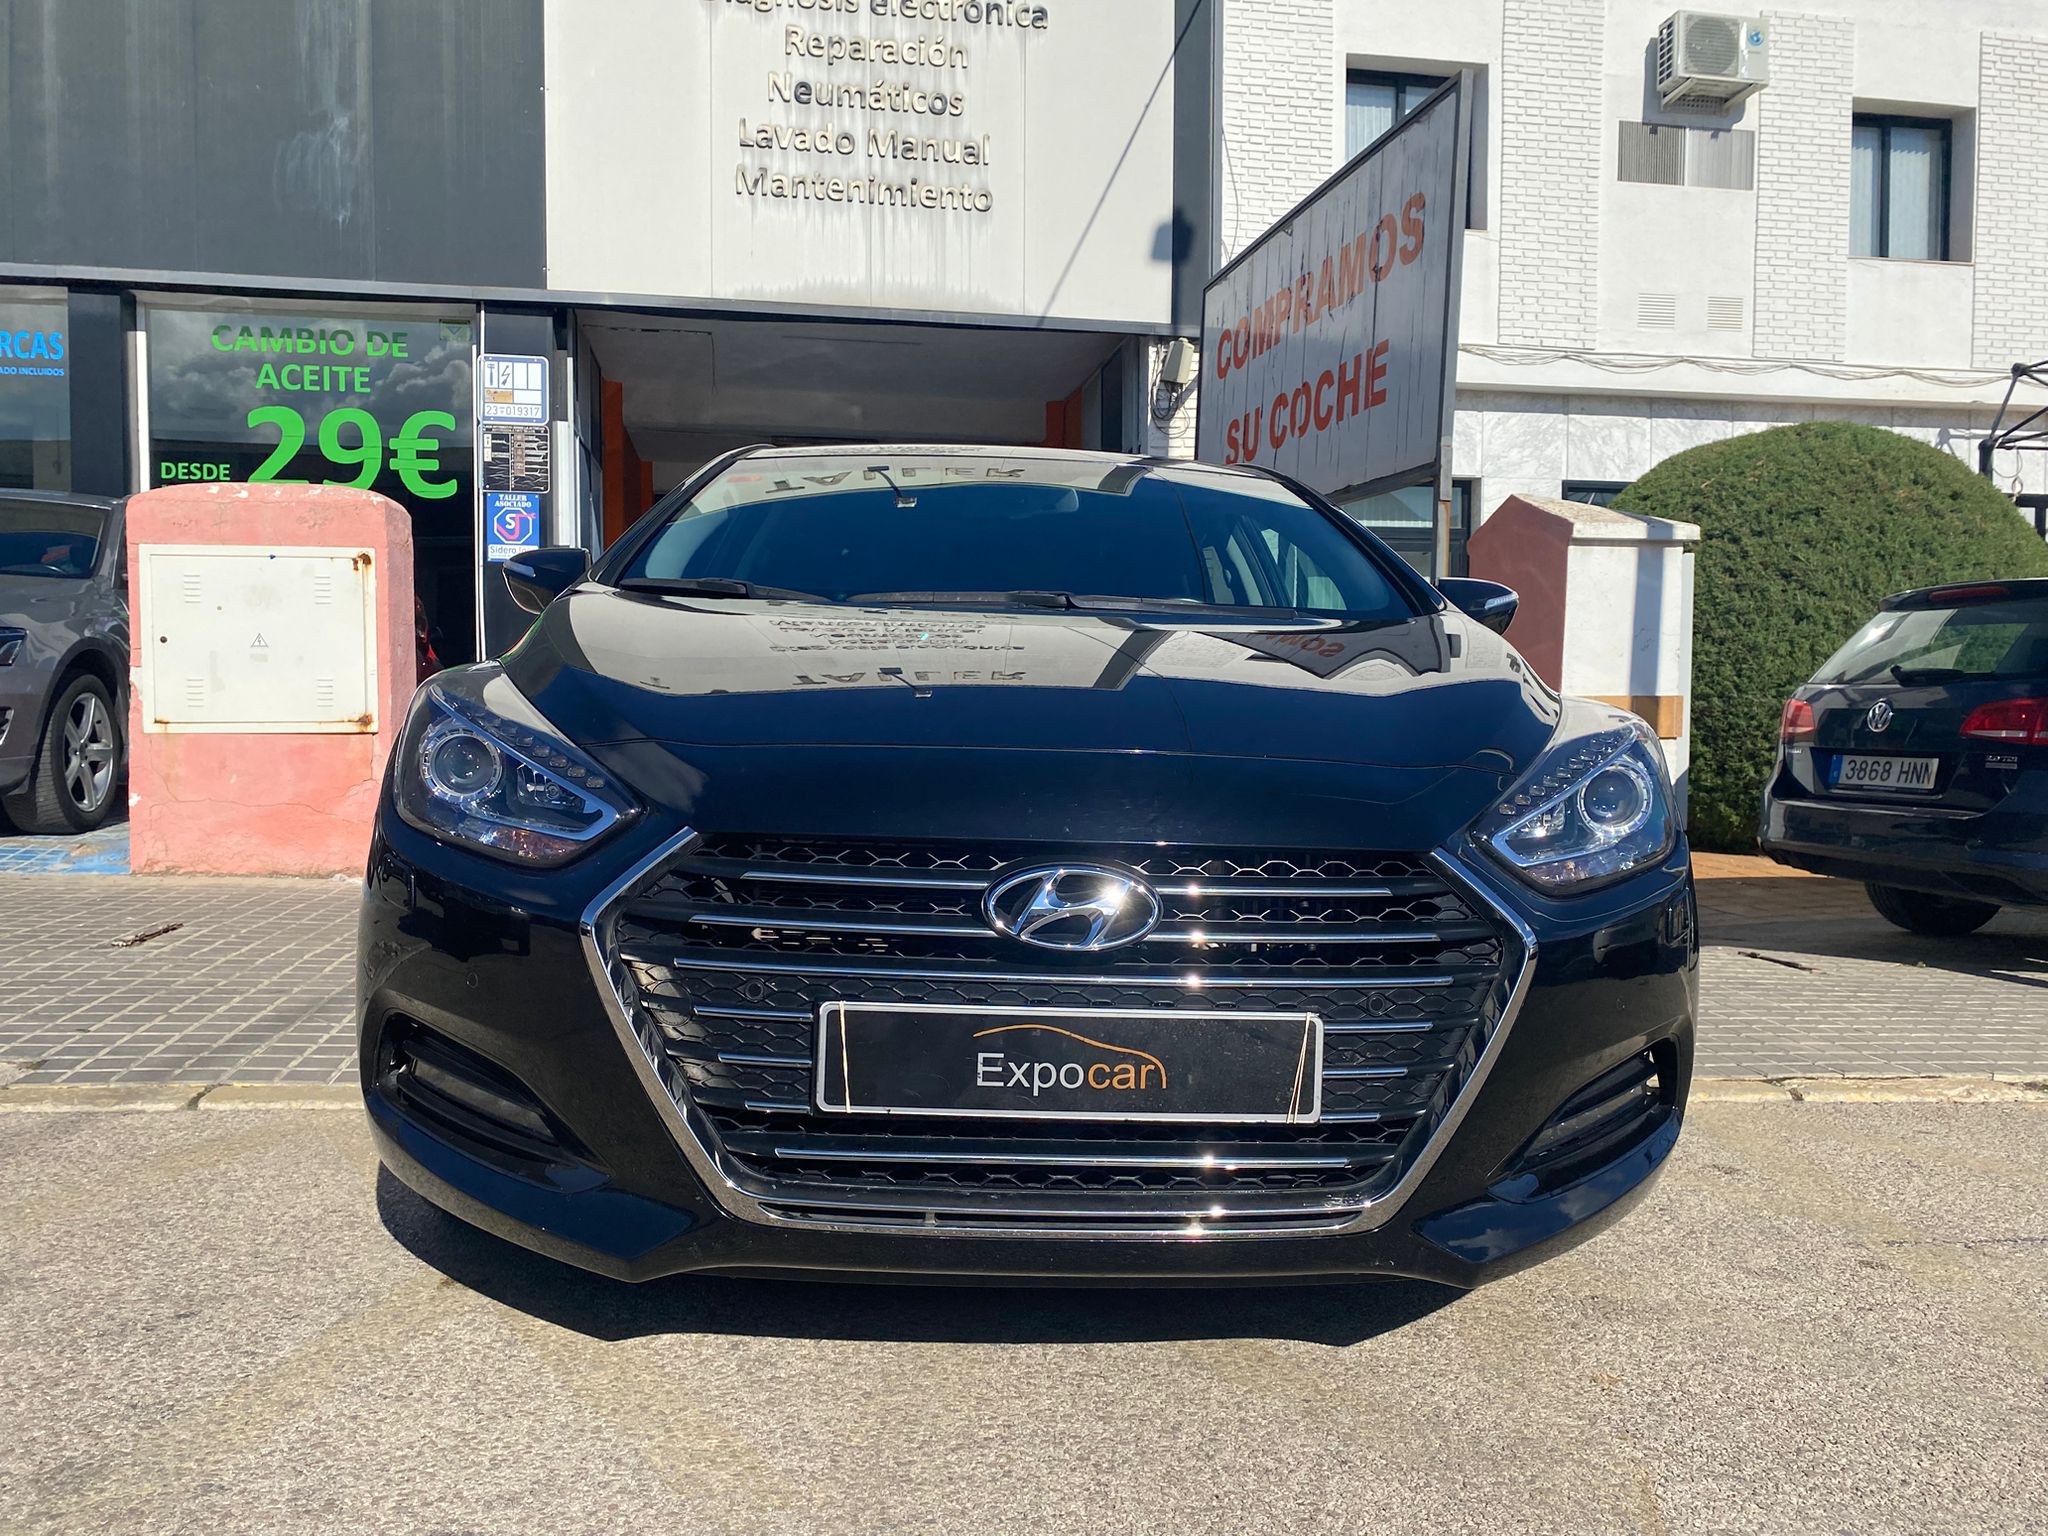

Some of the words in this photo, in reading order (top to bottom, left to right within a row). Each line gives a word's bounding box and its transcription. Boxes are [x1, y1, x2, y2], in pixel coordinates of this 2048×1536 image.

[785, 24, 969, 70] Reparación
[767, 71, 965, 116] Neumáticos
[738, 117, 856, 155] Lavado
[866, 127, 991, 166] Manual
[735, 163, 993, 212] Mantenimiento
[1216, 191, 1426, 380] COMPRAMOS
[211, 325, 355, 356] CAMBIO
[366, 330, 409, 358] DE
[255, 363, 371, 393] ACEITE
[1225, 406, 1261, 466] SU
[1269, 339, 1390, 450] COCHE
[160, 462, 231, 481] DESDE
[247, 405, 458, 499] 29€
[1845, 759, 1892, 782] 3868
[1897, 760, 1933, 784] HNN
[976, 1051, 1155, 1096] Expocar
